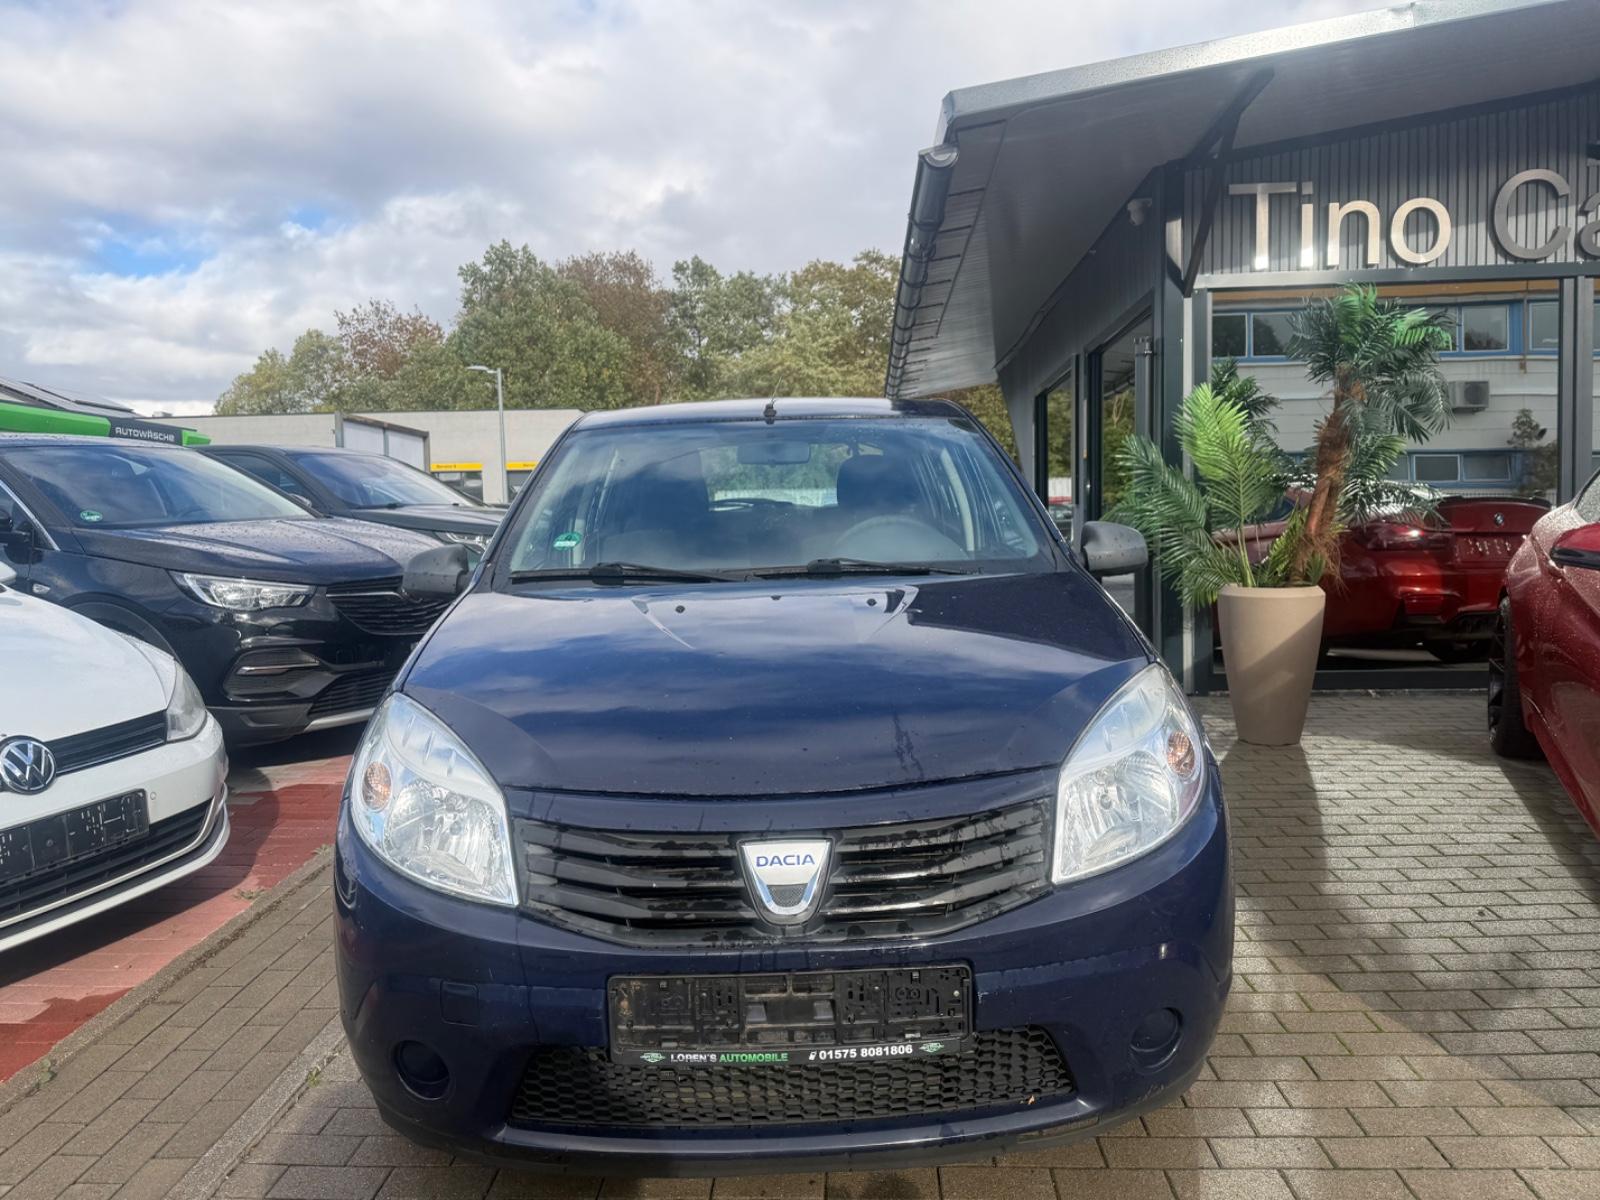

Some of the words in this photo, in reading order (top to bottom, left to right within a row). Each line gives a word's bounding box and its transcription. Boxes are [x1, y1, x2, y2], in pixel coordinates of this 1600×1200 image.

[1228, 181, 1452, 270] Tino
[756, 854, 815, 867] DACIA
[670, 1053, 717, 1063] LOREN'S
[719, 1053, 788, 1063] AUTOMOBILE
[818, 1048, 857, 1060] 01575
[860, 1044, 913, 1058] 8081806
